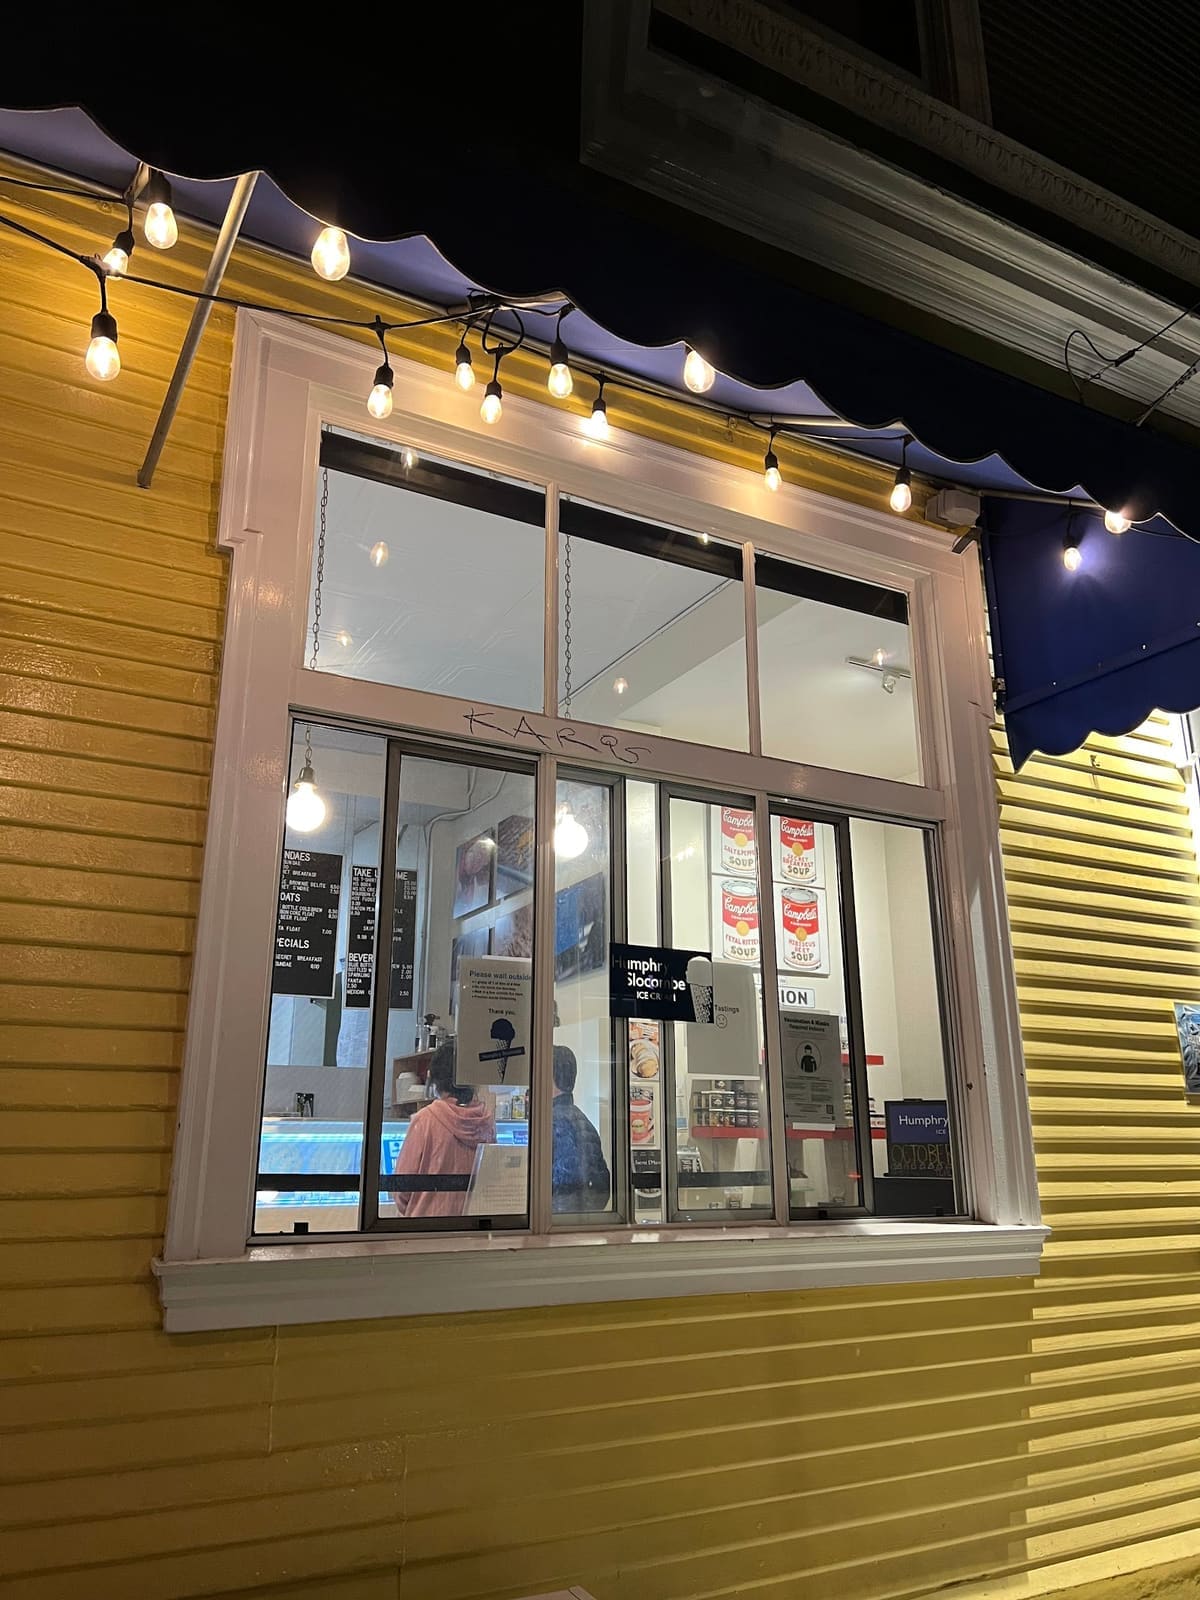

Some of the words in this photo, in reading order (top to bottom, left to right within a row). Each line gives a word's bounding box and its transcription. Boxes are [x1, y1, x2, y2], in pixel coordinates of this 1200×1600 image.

[729, 856, 753, 867] SOUP
[353, 868, 372, 877] TAKE
[787, 865, 810, 876] SOUP
[280, 892, 301, 902] OATS
[731, 945, 756, 956] SOUP
[349, 953, 374, 962] BEVER
[791, 951, 814, 961] SOUP
[636, 990, 649, 1000] ICE
[781, 990, 808, 1005] ION
[898, 1115, 948, 1128] Humphry
